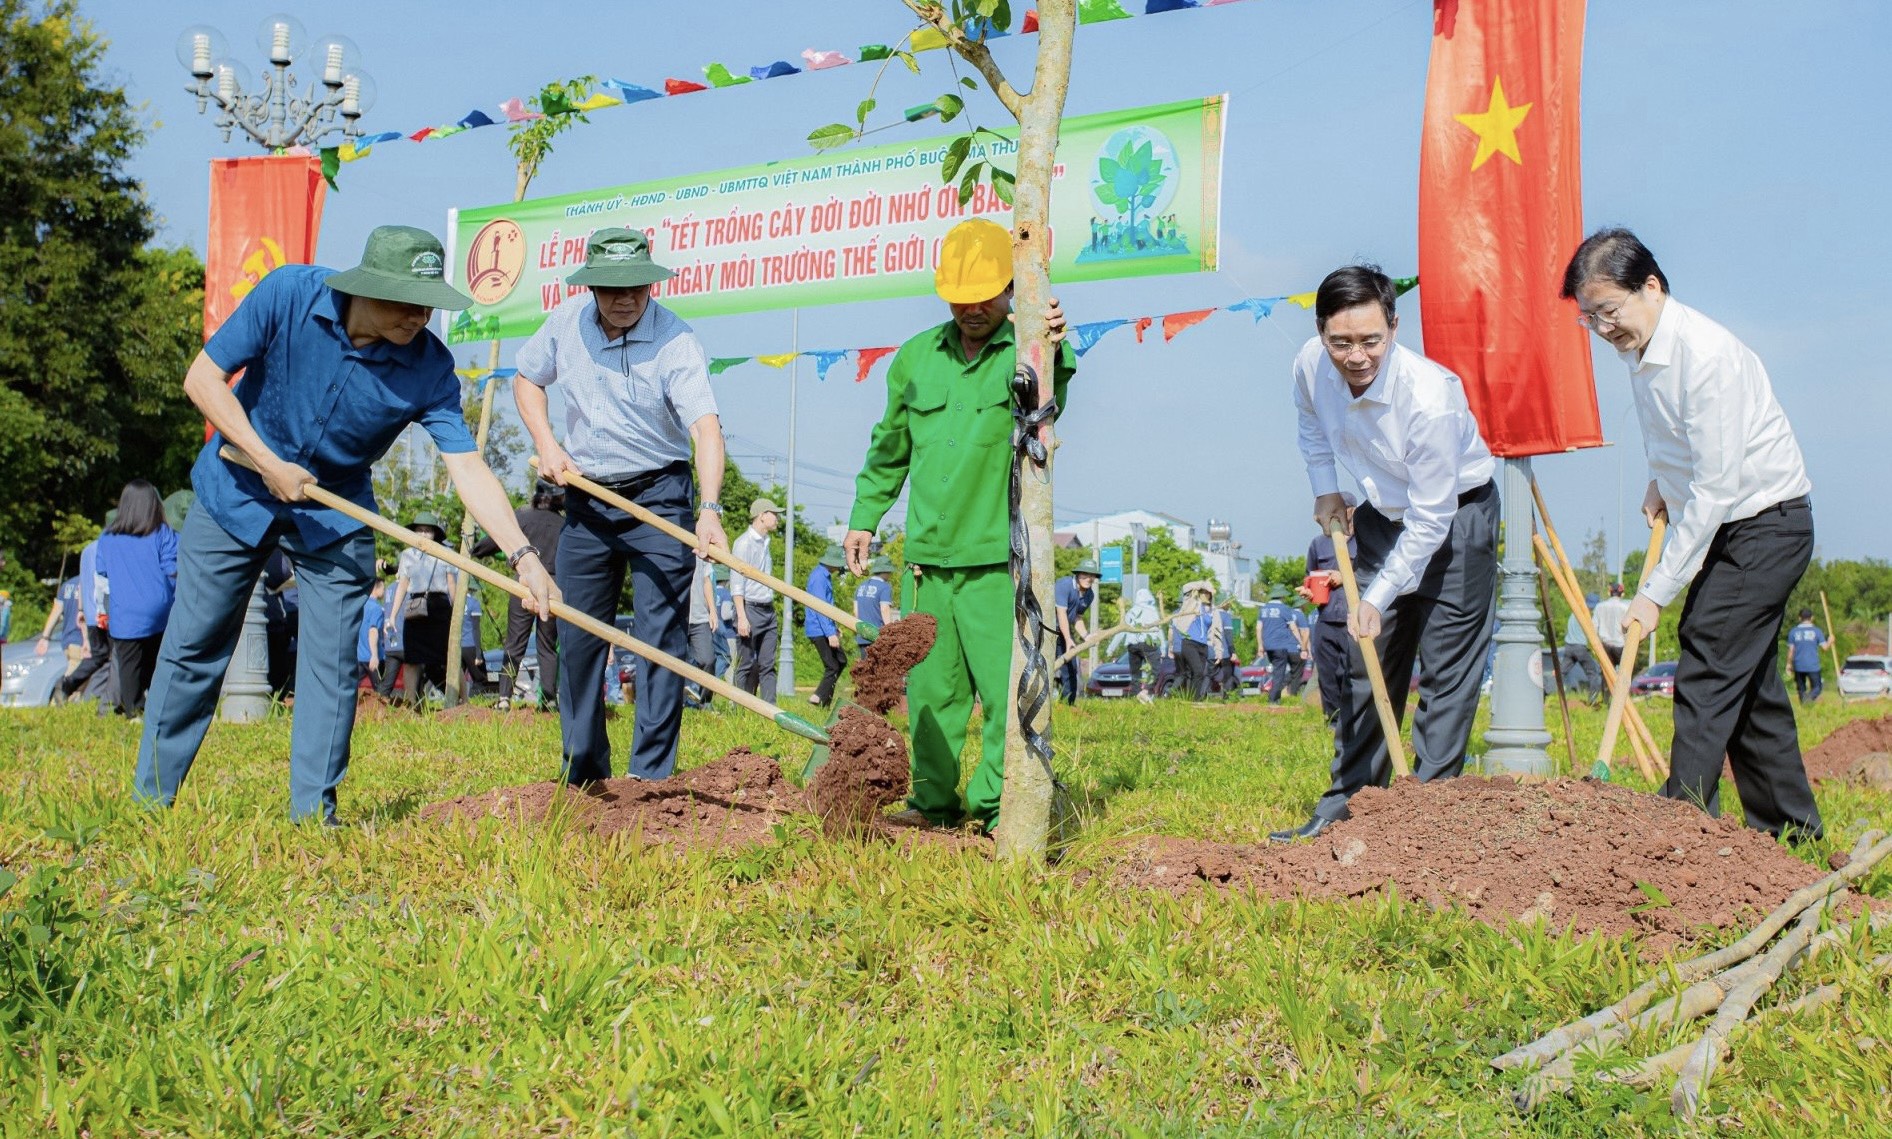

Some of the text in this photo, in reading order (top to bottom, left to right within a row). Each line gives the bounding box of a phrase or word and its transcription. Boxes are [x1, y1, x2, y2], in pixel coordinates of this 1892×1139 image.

[631, 193, 666, 206] HĐND
[676, 186, 709, 200] UBND
[719, 176, 769, 194] UBMTTQ
[773, 170, 798, 188] VIỆT
[801, 167, 832, 183] NAM
[836, 159, 881, 177] THÀNH
[885, 149, 916, 170] PHỐ
[919, 147, 947, 166] BUÔ
[540, 231, 559, 268] LỄ
[769, 202, 806, 238] CÂY
[888, 184, 931, 224] NHỚ
[542, 277, 561, 311] VÀ
[667, 258, 715, 296] NGÀY
[719, 253, 756, 290] MÔI
[843, 234, 880, 276] THẾ
[884, 233, 925, 272] GIỚI
